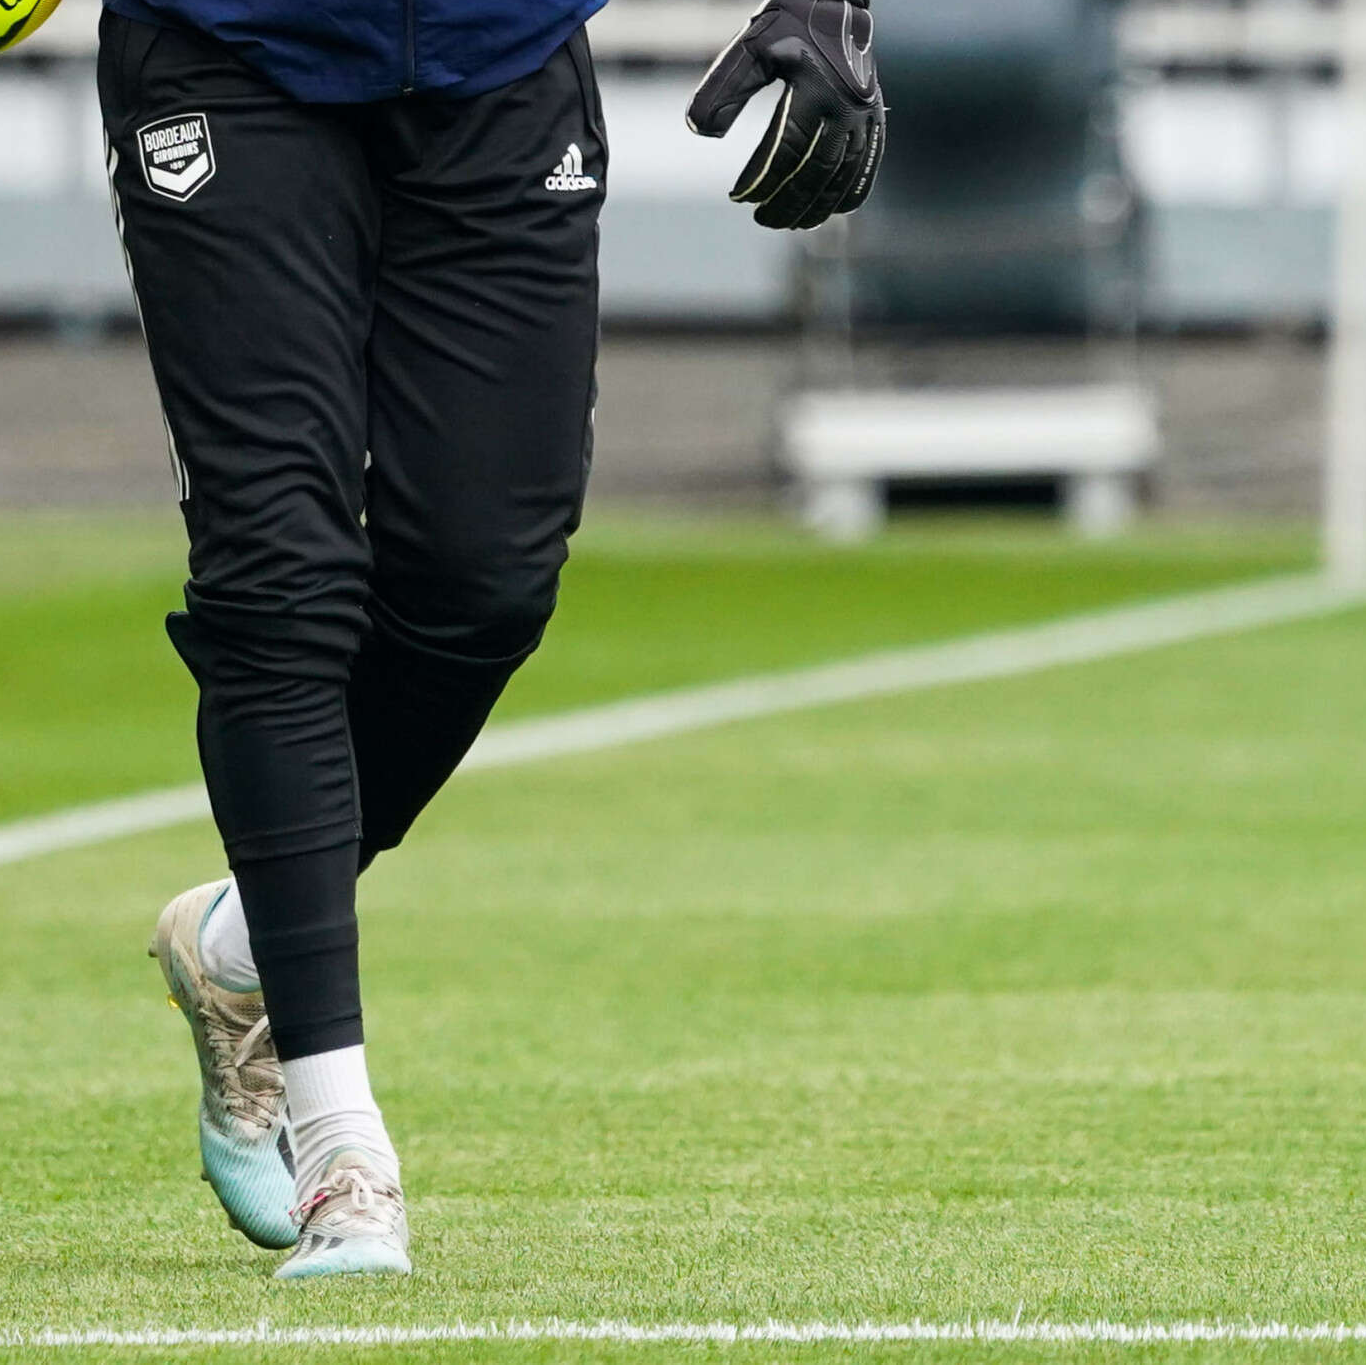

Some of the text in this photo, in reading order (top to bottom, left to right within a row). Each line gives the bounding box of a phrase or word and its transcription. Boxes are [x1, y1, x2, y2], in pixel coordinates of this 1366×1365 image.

[143, 120, 204, 152] BORDEAUX
[153, 141, 200, 165] GIRONDINS
[545, 173, 597, 191] adidas
